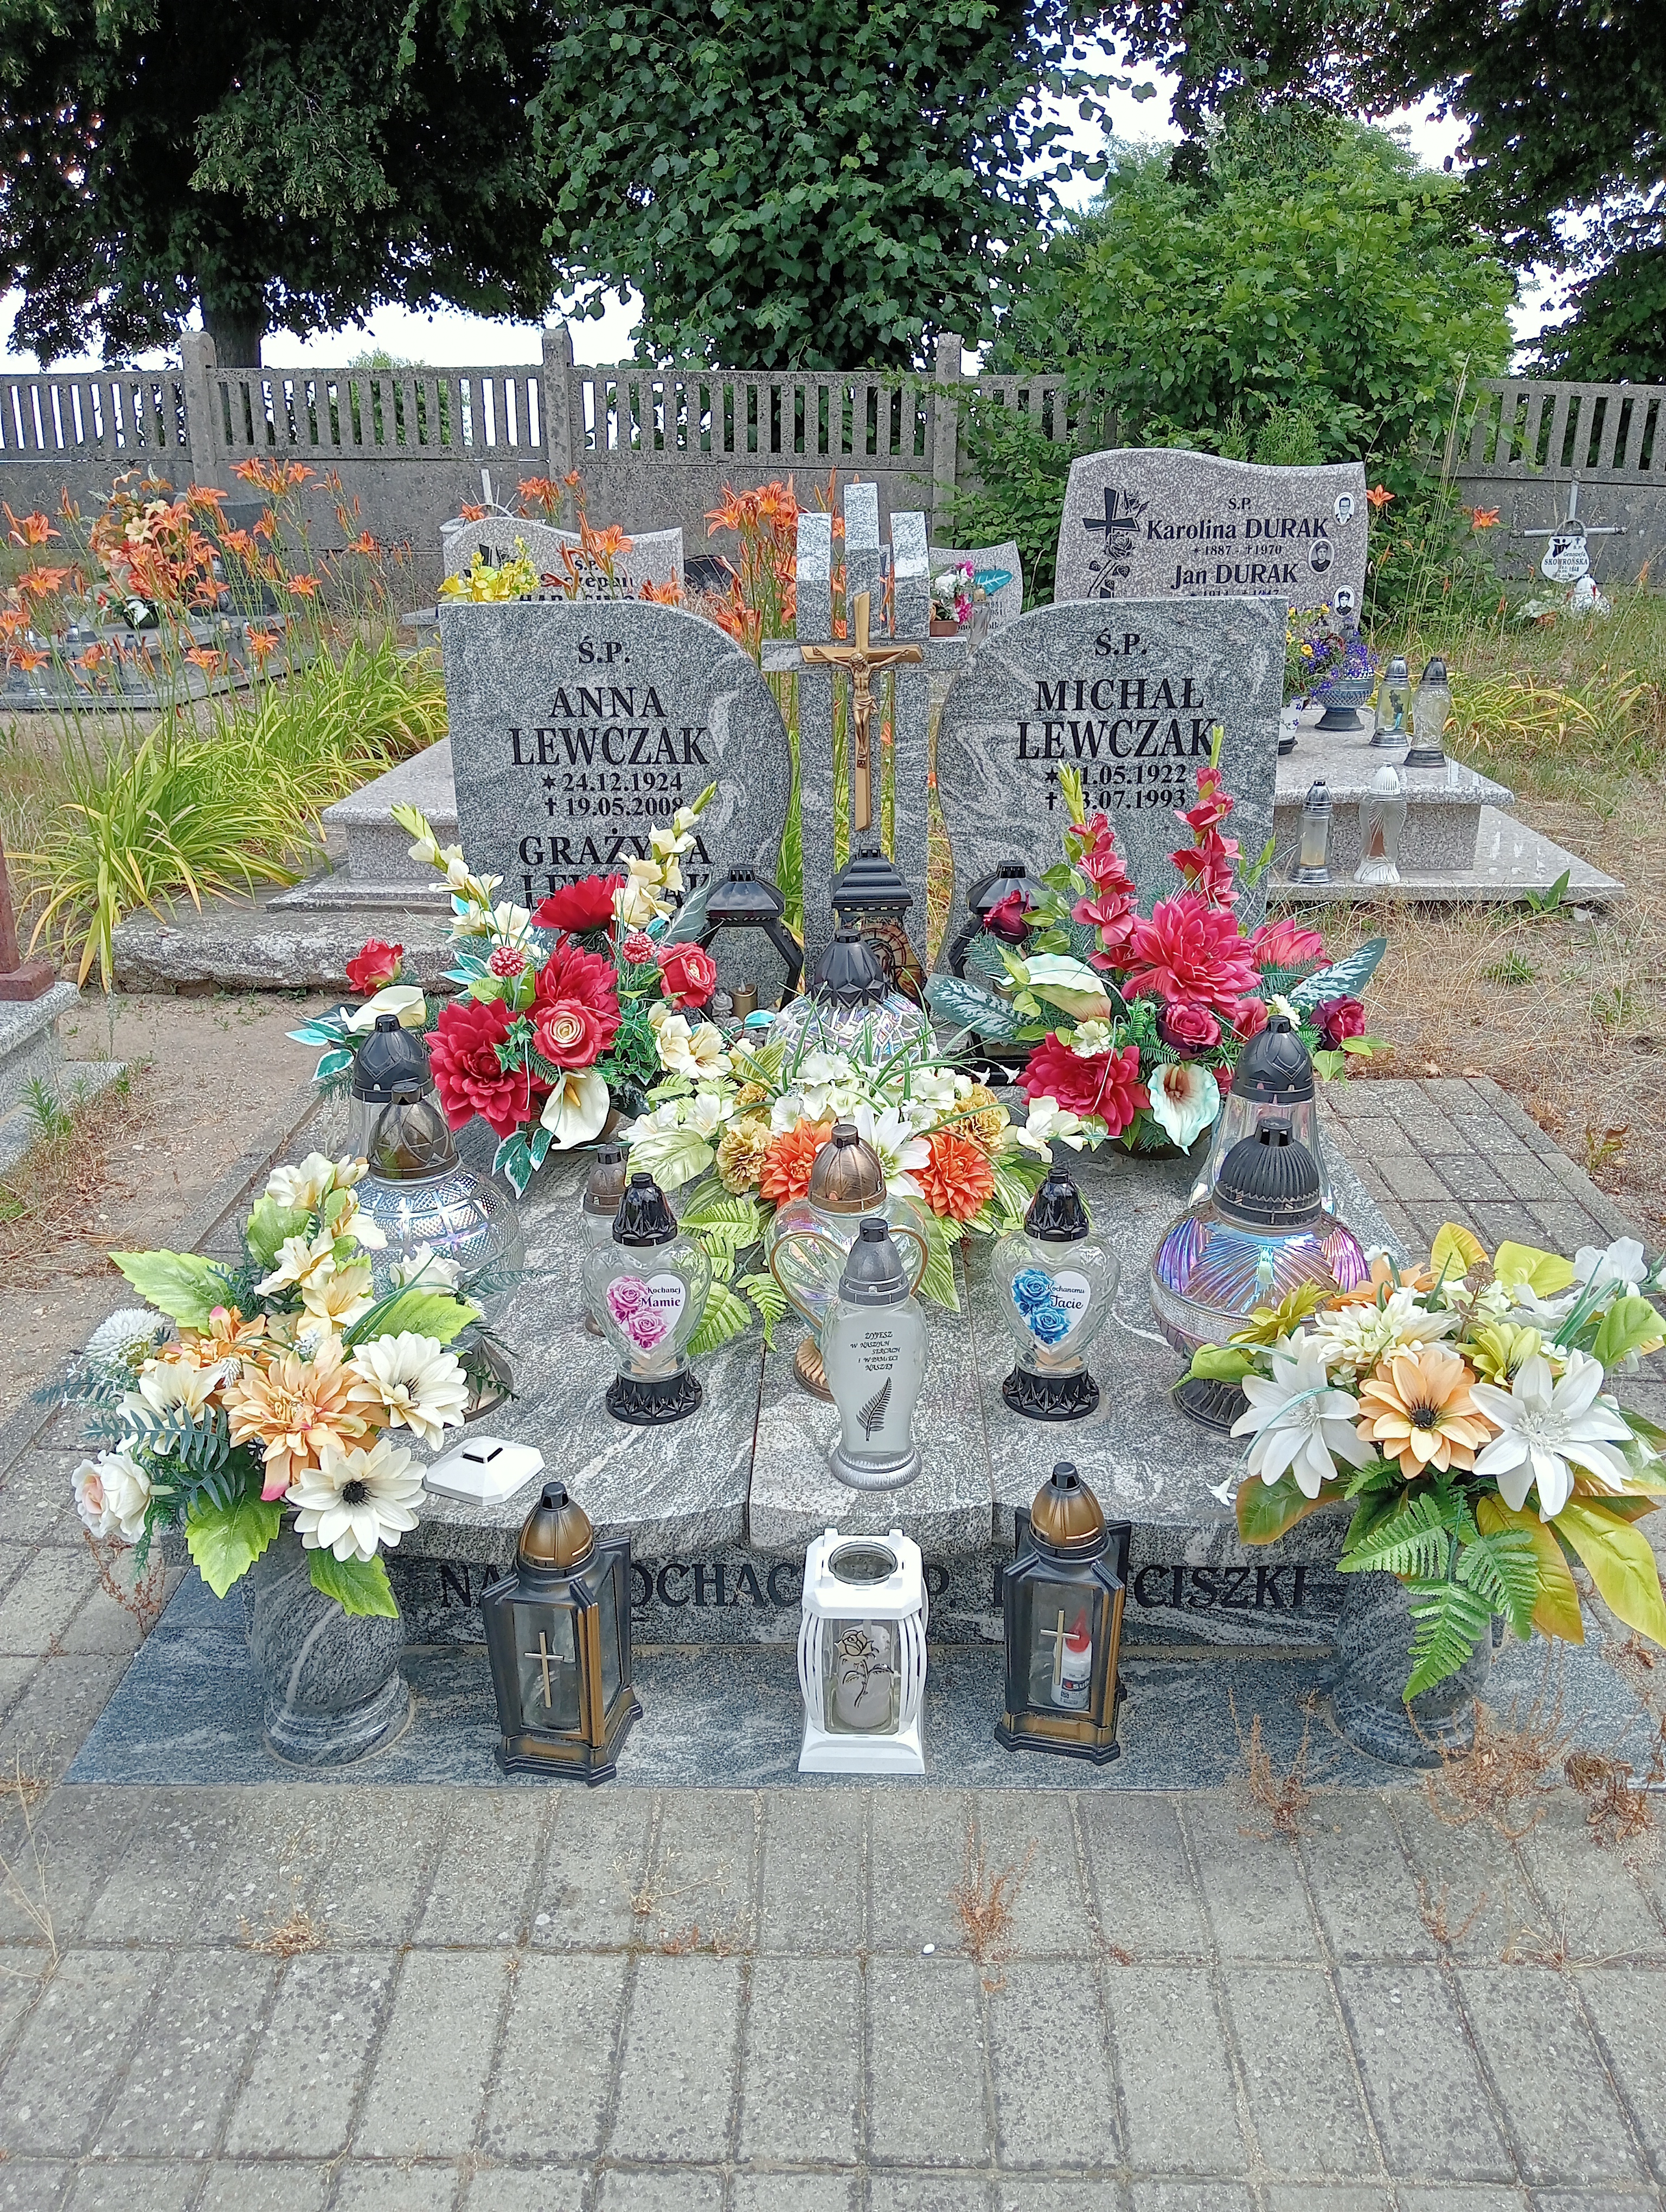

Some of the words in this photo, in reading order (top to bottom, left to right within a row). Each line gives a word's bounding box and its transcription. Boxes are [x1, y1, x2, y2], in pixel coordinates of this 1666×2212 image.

[1146, 519, 1236, 540] Karolina
[1244, 518, 1329, 538] DURAK
[1205, 545, 1232, 555] 1887
[1170, 564, 1207, 589] Jan
[1215, 563, 1299, 584] DURAK
[578, 636, 630, 664] Ś.P.
[1094, 628, 1147, 655] Ś.P.
[548, 686, 668, 718] ANNA
[1033, 678, 1203, 711] MICHAŁ
[508, 726, 710, 766] LEWCZAK
[1016, 718, 1218, 760] LEWCZAK
[562, 773, 683, 792] 24.12.1924
[1069, 764, 1187, 785] 1.05.1922
[566, 797, 684, 816] 19.05.2008
[1069, 789, 1186, 810] 3.07.1993
[518, 827, 713, 865] GRAŻYA
[645, 1287, 681, 1295] Kochanej
[1045, 1284, 1085, 1294] Kochanemu
[638, 1295, 681, 1308] Mamie
[1049, 1295, 1084, 1309] Tacie
